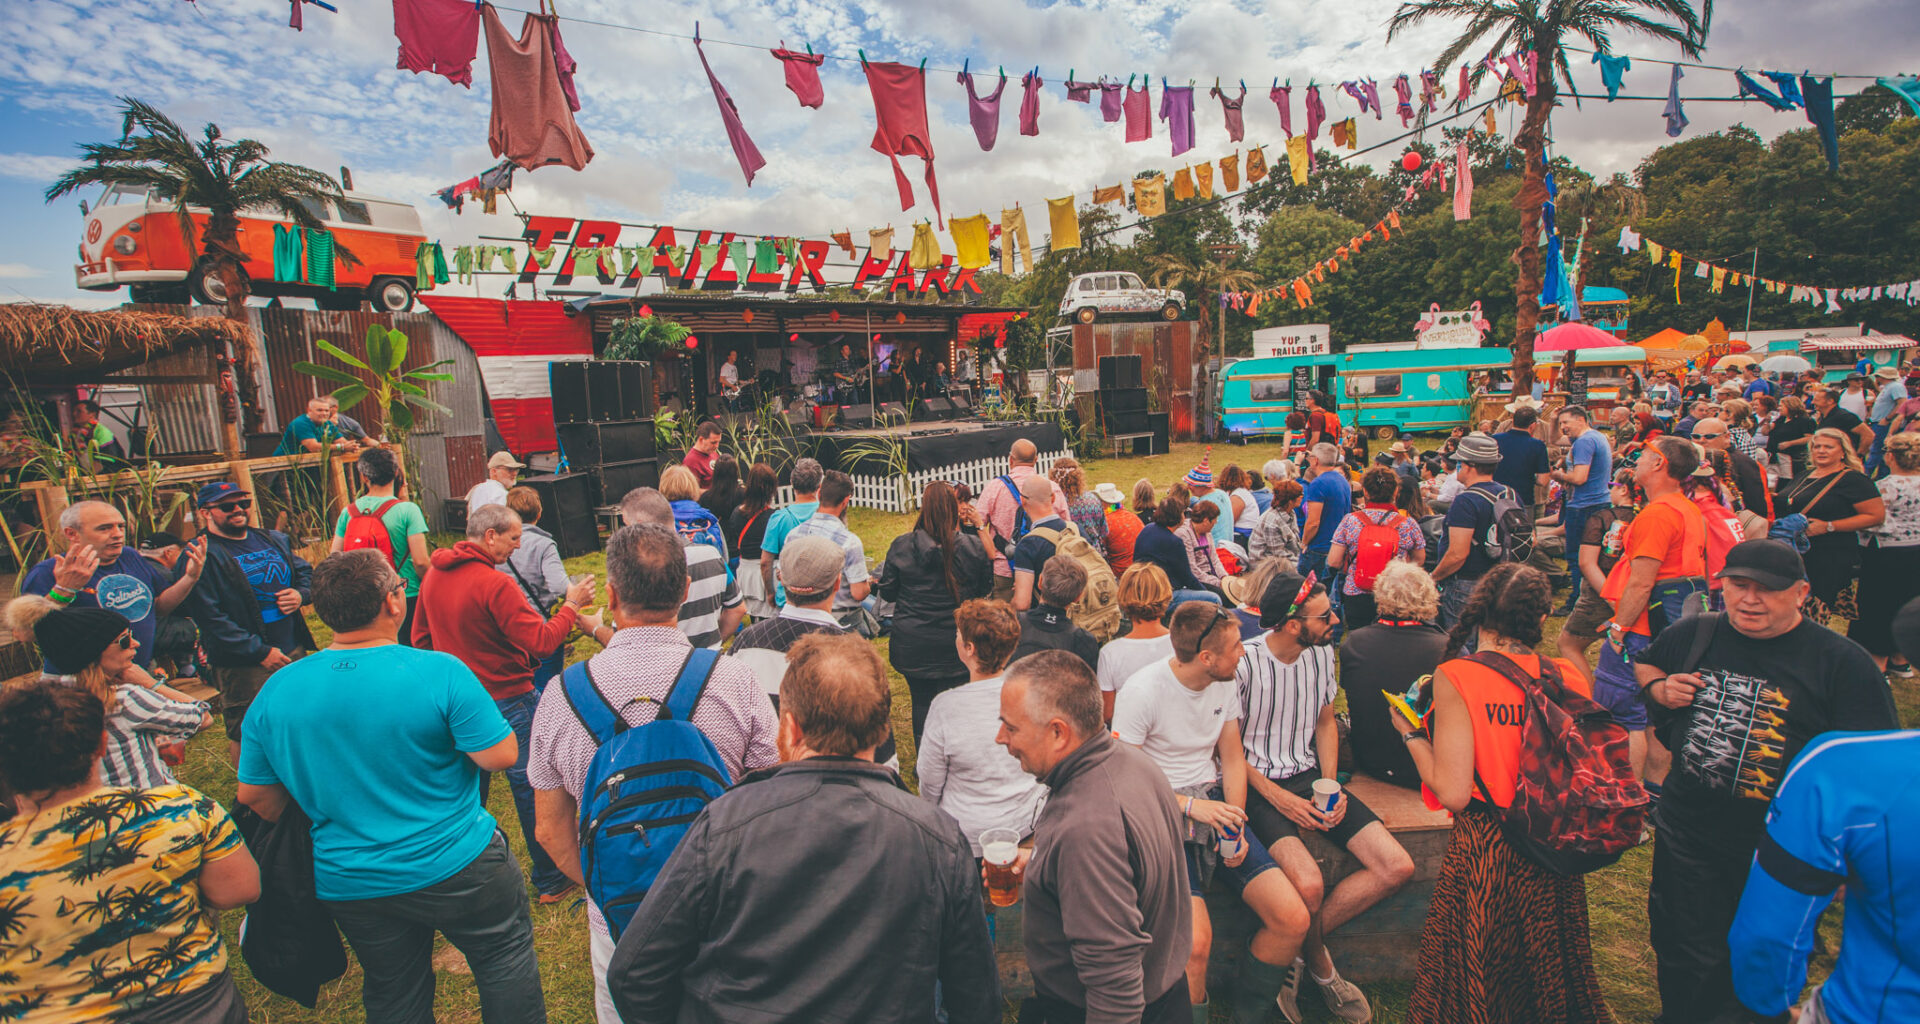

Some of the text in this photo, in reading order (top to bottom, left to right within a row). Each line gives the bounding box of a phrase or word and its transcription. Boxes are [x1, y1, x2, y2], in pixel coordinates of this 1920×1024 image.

[519, 215, 983, 299] TRAILER PARK
[1281, 335, 1300, 345] YUP
[1271, 345, 1308, 357] TRAILER
[105, 583, 147, 609] Saltrock
